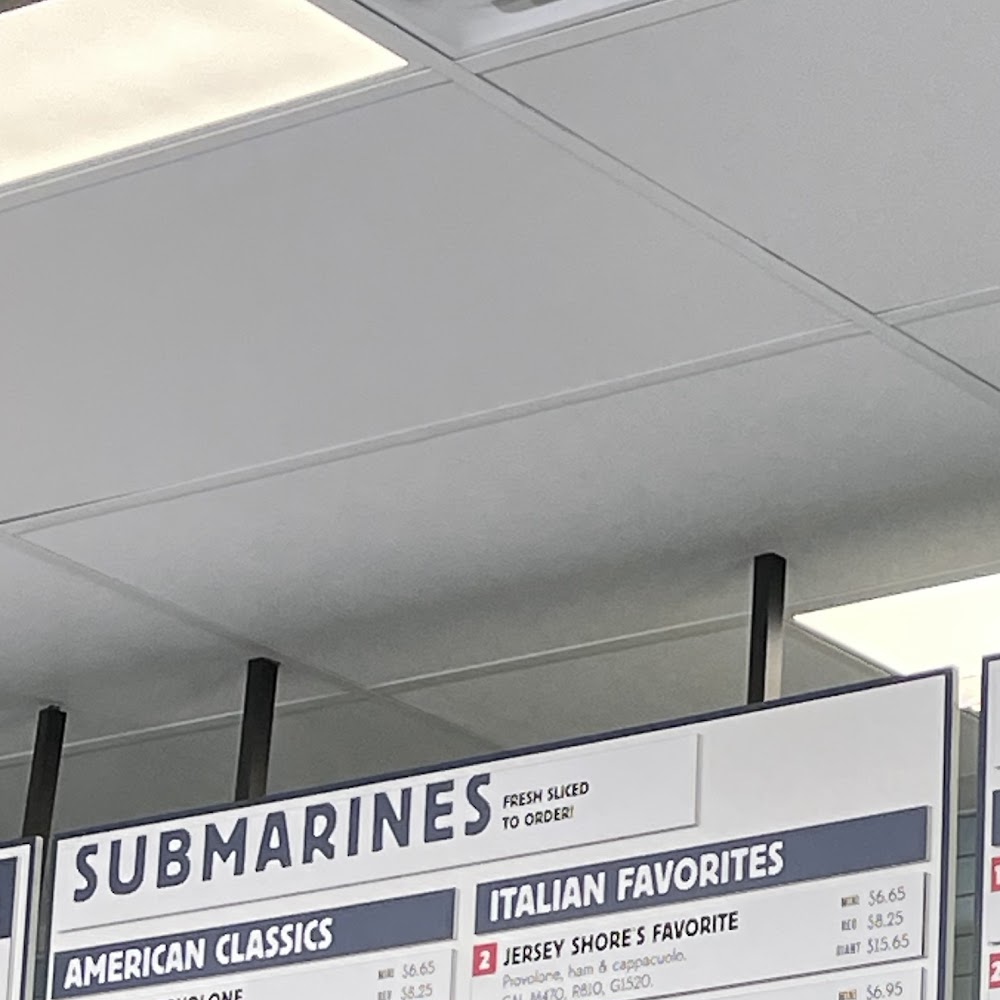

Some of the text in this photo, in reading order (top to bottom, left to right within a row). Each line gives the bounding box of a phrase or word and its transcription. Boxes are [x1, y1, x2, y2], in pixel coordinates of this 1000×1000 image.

[502, 781, 590, 809] FRESH SLICED
[502, 806, 574, 830] TO ORDER!
[73, 774, 490, 902] SUBMARINES
[489, 841, 784, 922] ITALIAN FAVORITES
[63, 917, 333, 990] AMERICAN CLASSICS
[478, 910, 739, 971] 2 JERSEY SHORE'S FAVORITE
